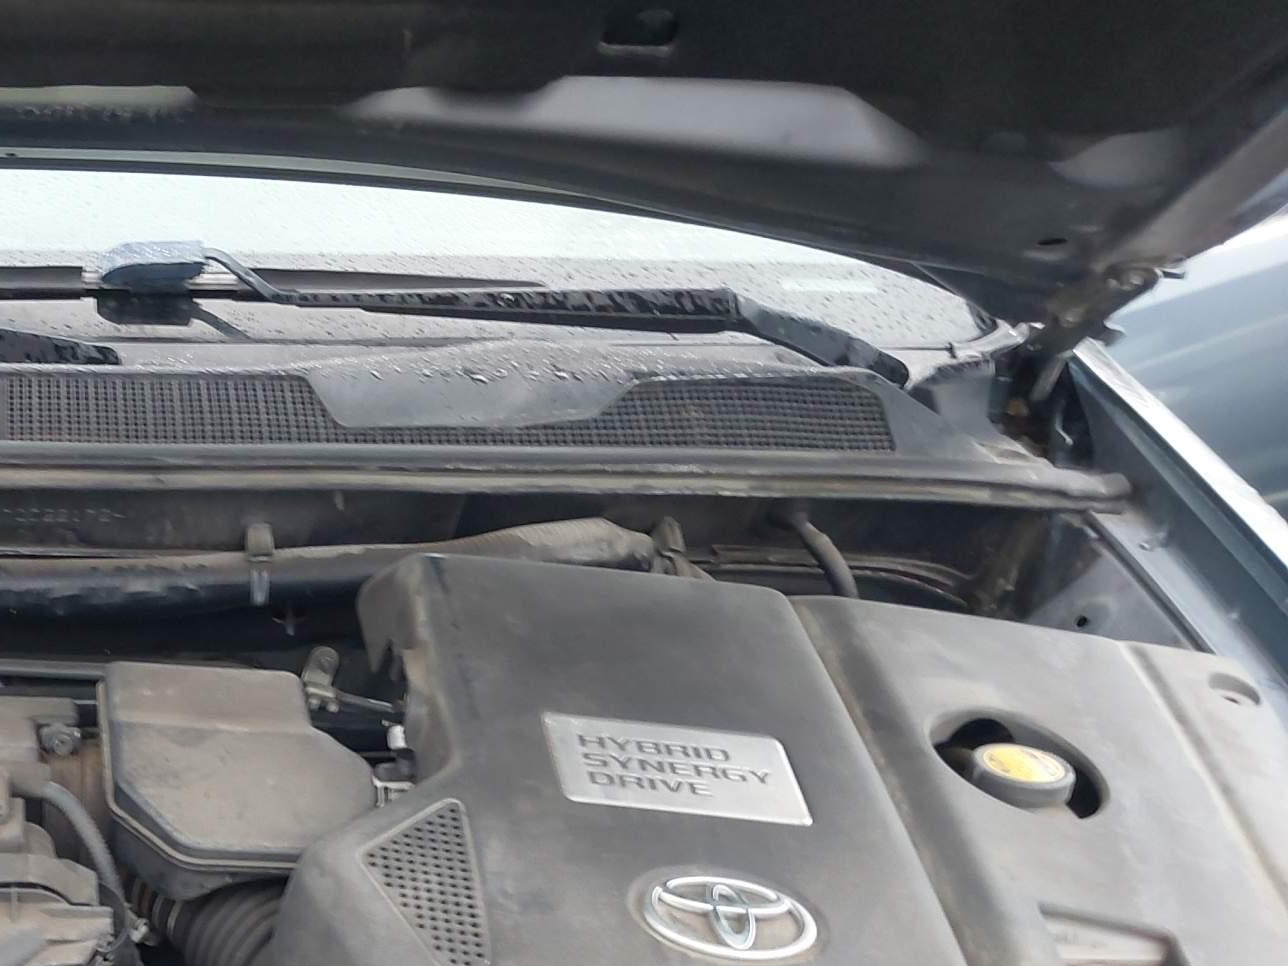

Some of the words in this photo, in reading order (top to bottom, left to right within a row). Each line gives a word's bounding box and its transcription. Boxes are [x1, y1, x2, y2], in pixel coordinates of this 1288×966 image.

[576, 732, 731, 763] HYBRID
[582, 751, 772, 785] SYNERGY
[586, 770, 714, 798] DRIVE
